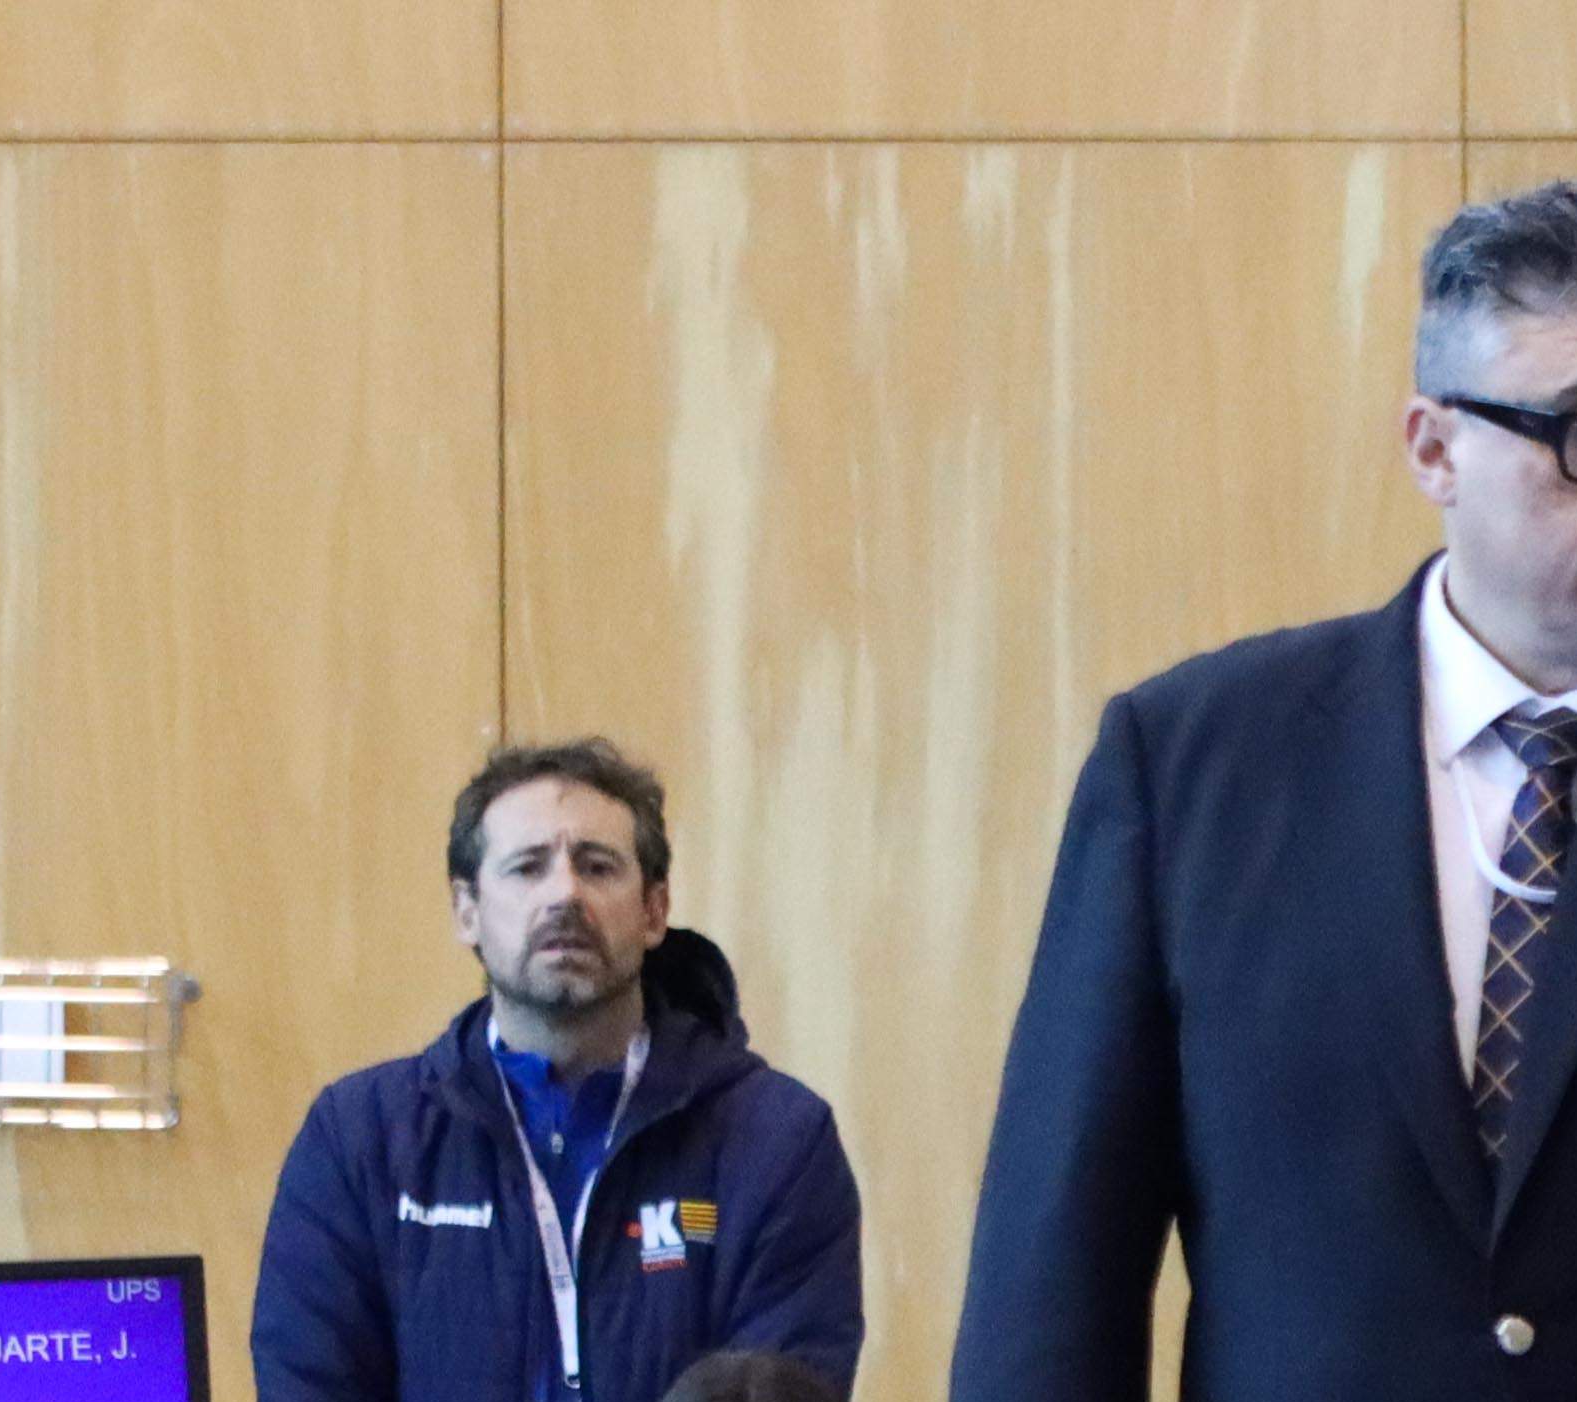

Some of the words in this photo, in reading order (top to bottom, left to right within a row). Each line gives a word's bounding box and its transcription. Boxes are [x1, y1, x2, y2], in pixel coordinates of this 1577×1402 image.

[398, 1190, 493, 1229] hummel
[107, 1279, 162, 1303] UPS
[111, 1331, 138, 1361] J.
